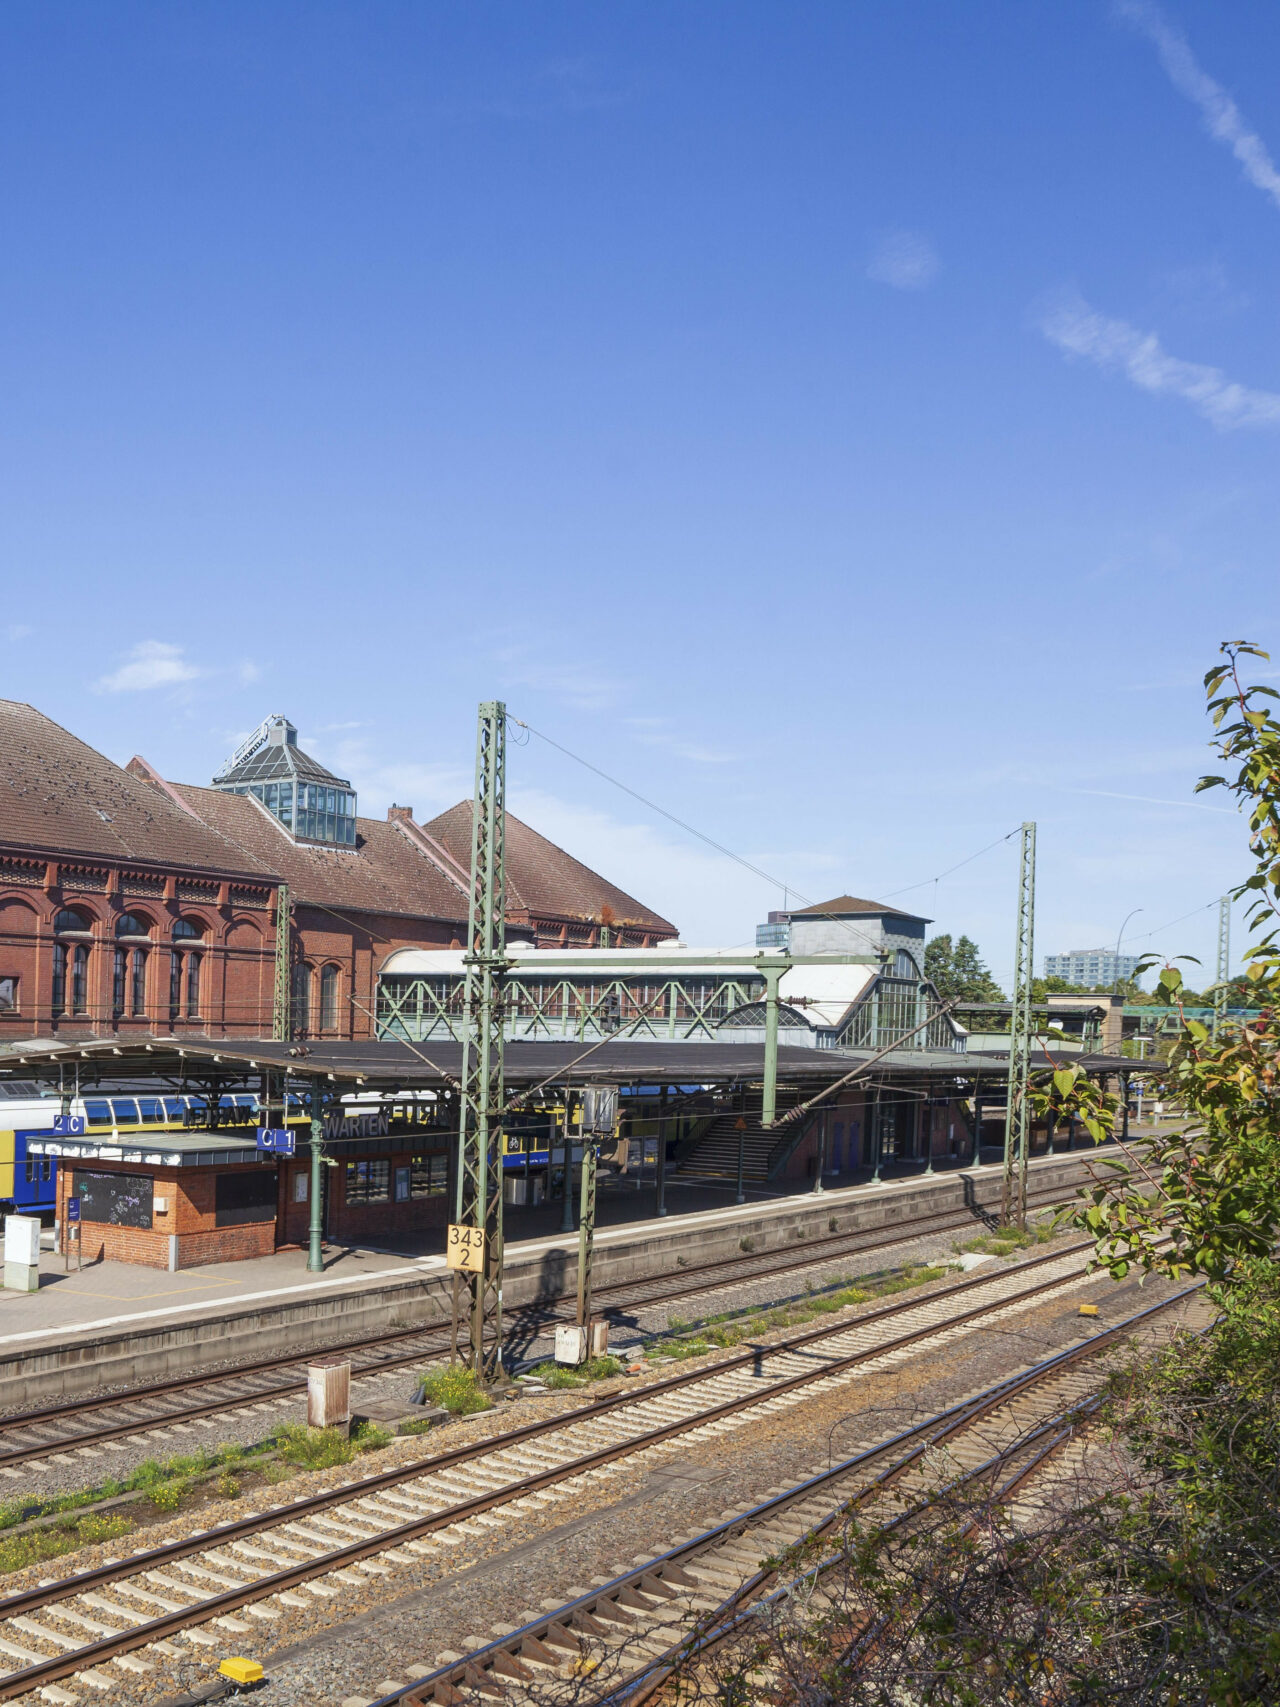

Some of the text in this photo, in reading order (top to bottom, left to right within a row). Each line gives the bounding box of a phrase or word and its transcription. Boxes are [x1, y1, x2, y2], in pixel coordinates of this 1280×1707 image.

[55, 1116, 79, 1132] 2 C
[324, 1115, 389, 1138] WARTEN
[262, 1130, 292, 1148] C 1
[450, 1228, 483, 1247] 343
[460, 1248, 470, 1266] 2
